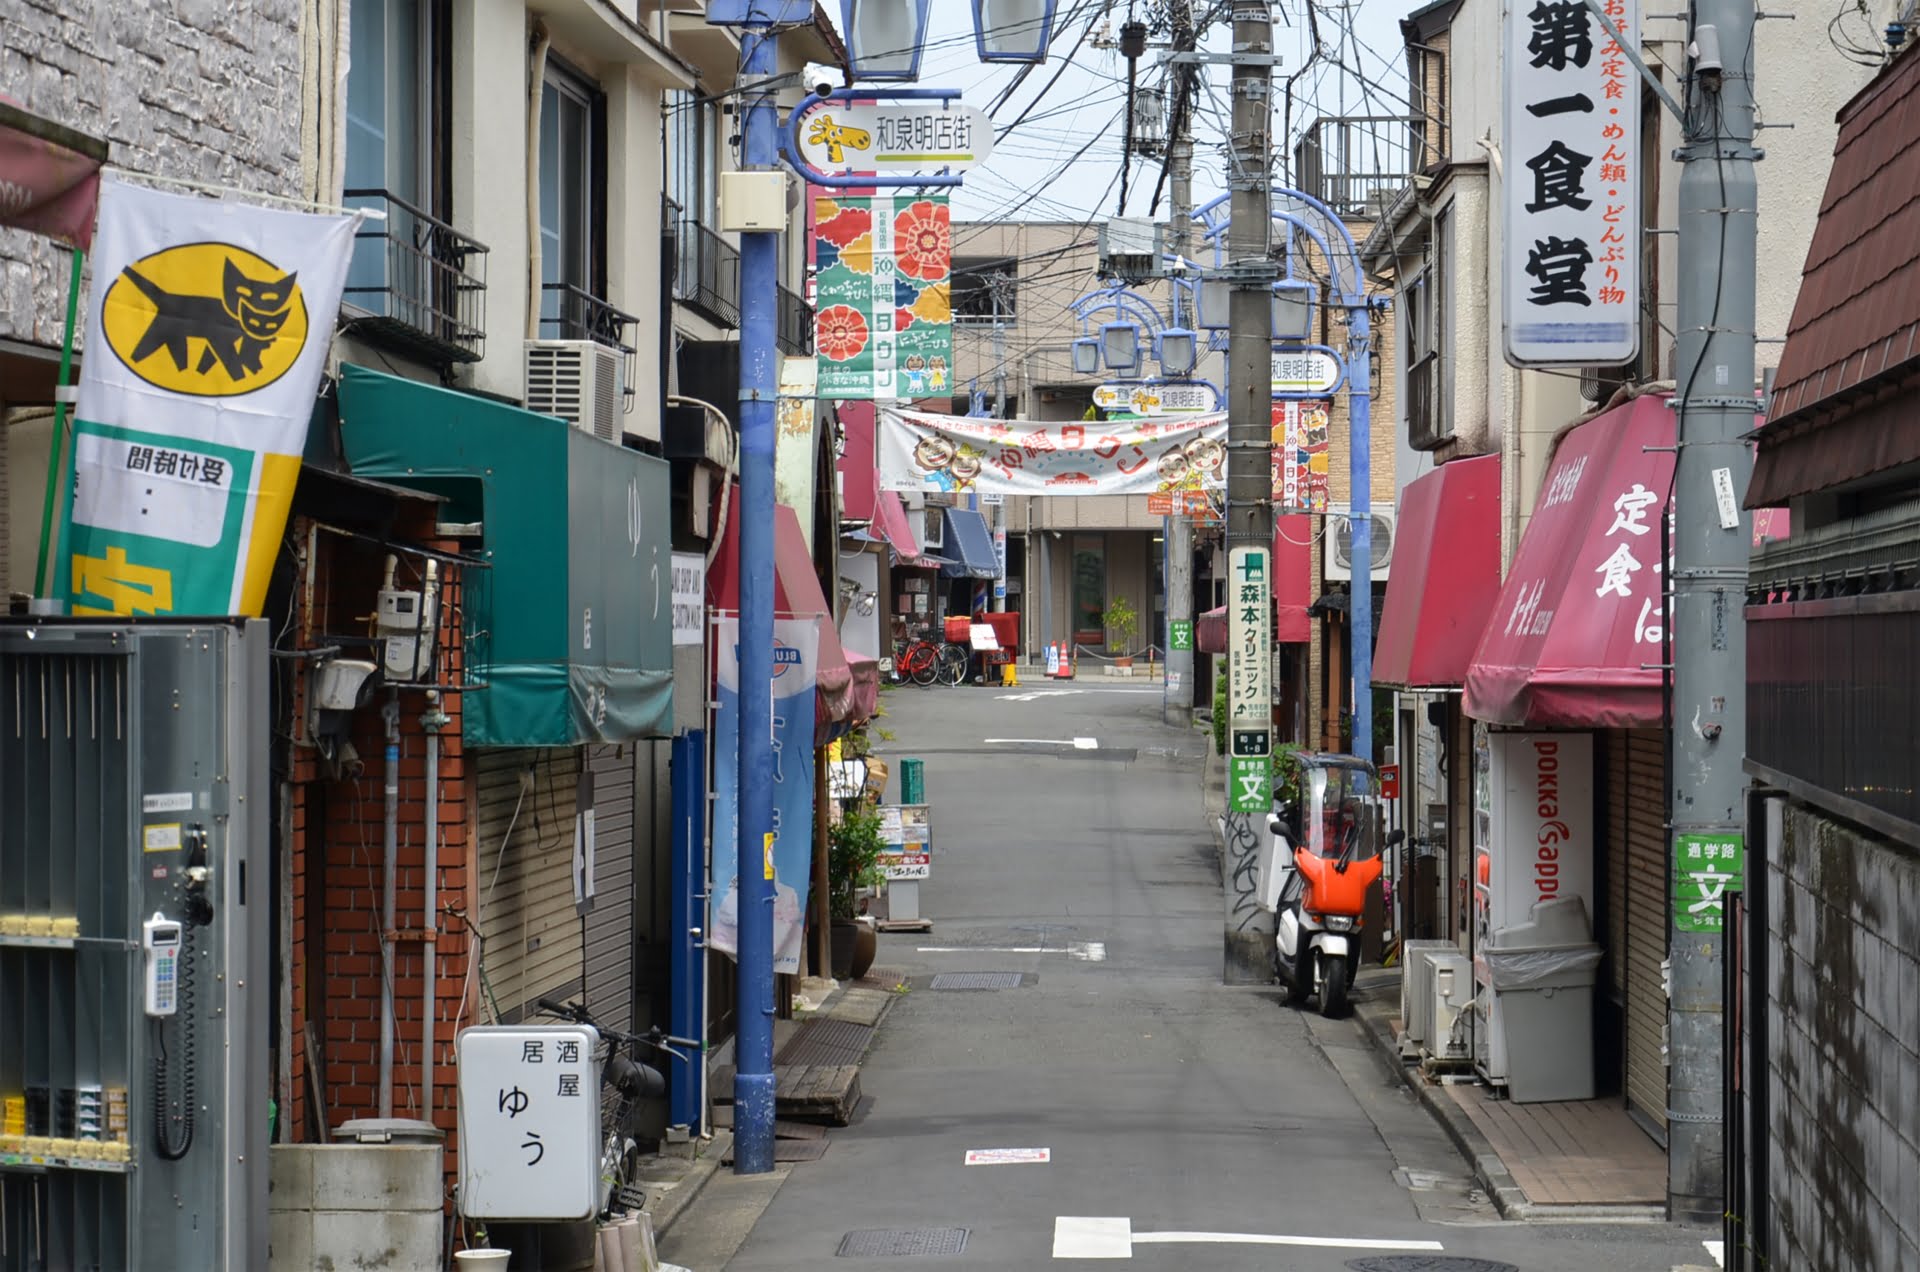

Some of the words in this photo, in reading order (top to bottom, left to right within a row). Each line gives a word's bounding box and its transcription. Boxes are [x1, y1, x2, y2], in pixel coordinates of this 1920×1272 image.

[876, 115, 972, 151] 和泉明店街
[1525, 0, 1594, 306] 第一食堂
[1161, 391, 1205, 408] 和泉明店街
[1595, 484, 1658, 598] 定食
[1240, 584, 1260, 699] 森本クリニック
[1244, 745, 1260, 753] 1-8
[1688, 843, 1734, 858] 通学路
[499, 1085, 544, 1166] ゆう
